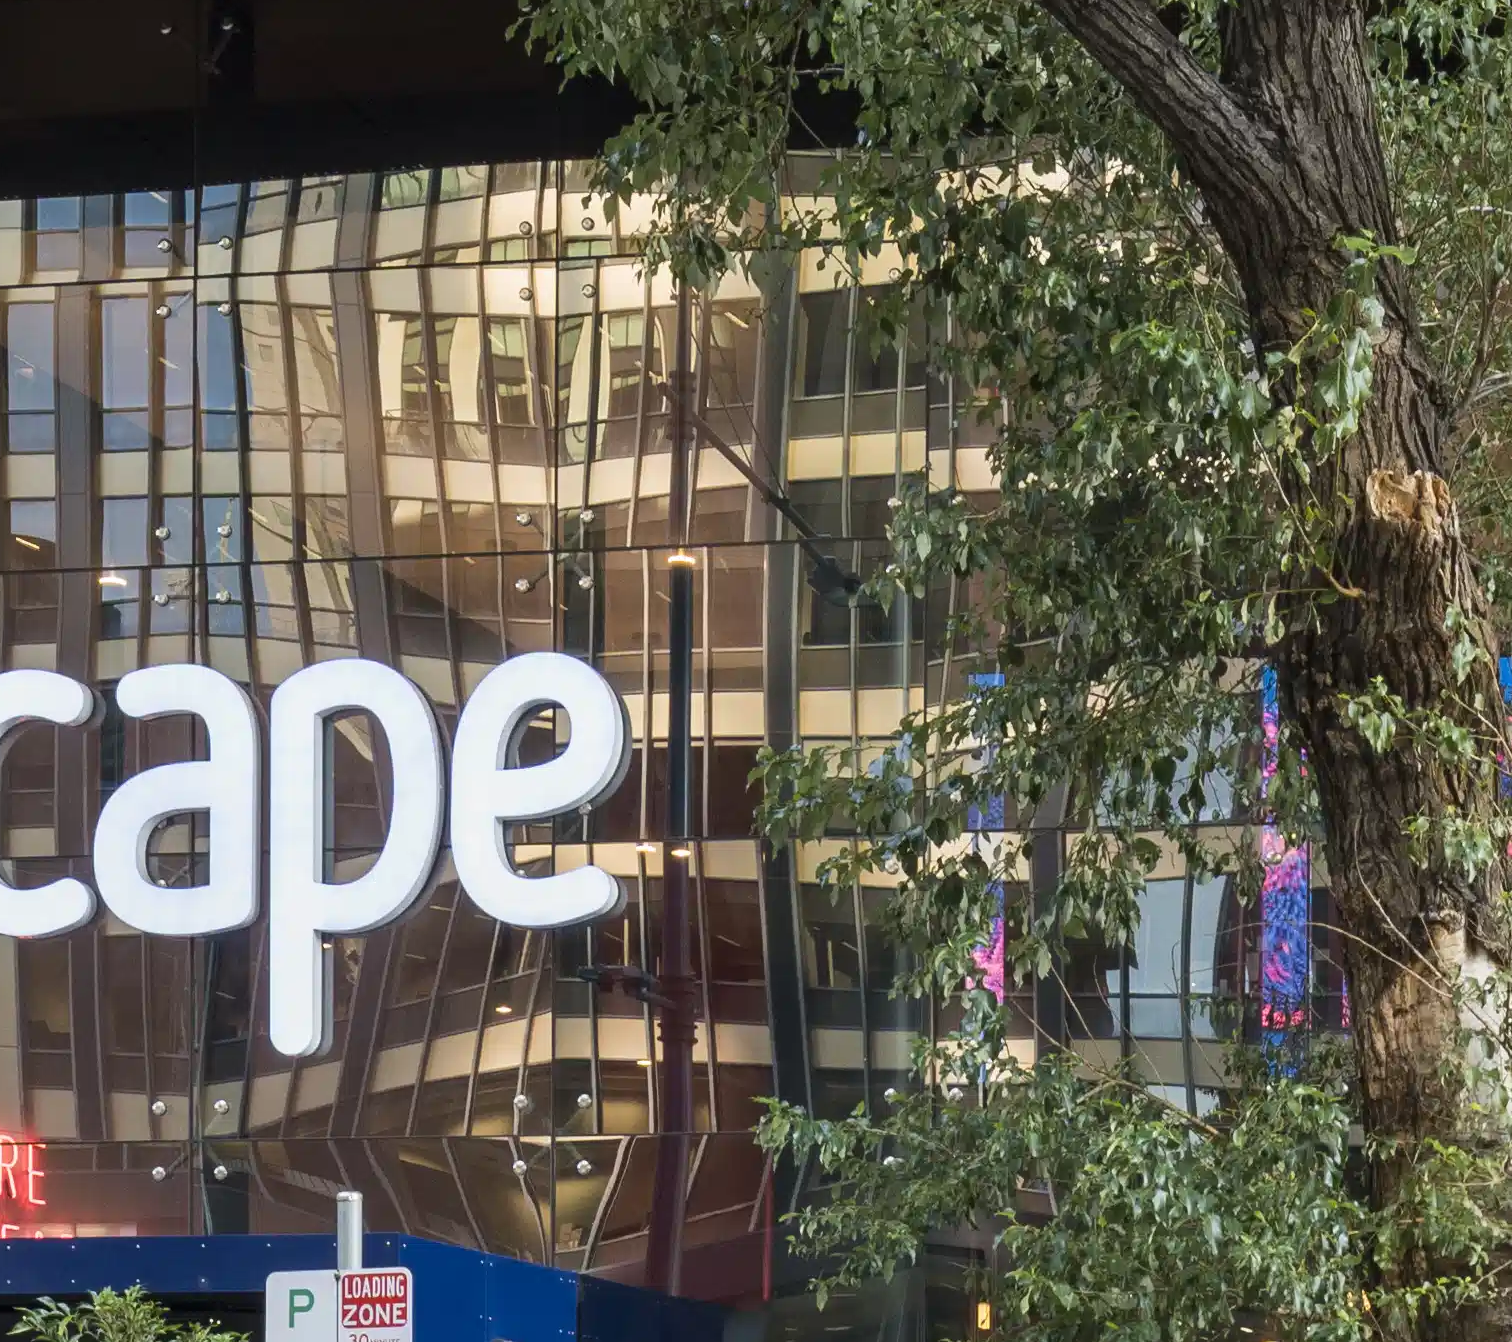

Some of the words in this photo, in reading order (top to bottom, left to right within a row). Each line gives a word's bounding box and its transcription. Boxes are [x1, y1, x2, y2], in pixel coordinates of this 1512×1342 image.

[345, 1275, 405, 1299] LOADING
[289, 1289, 315, 1328] P
[343, 1303, 406, 1326] ZONE
